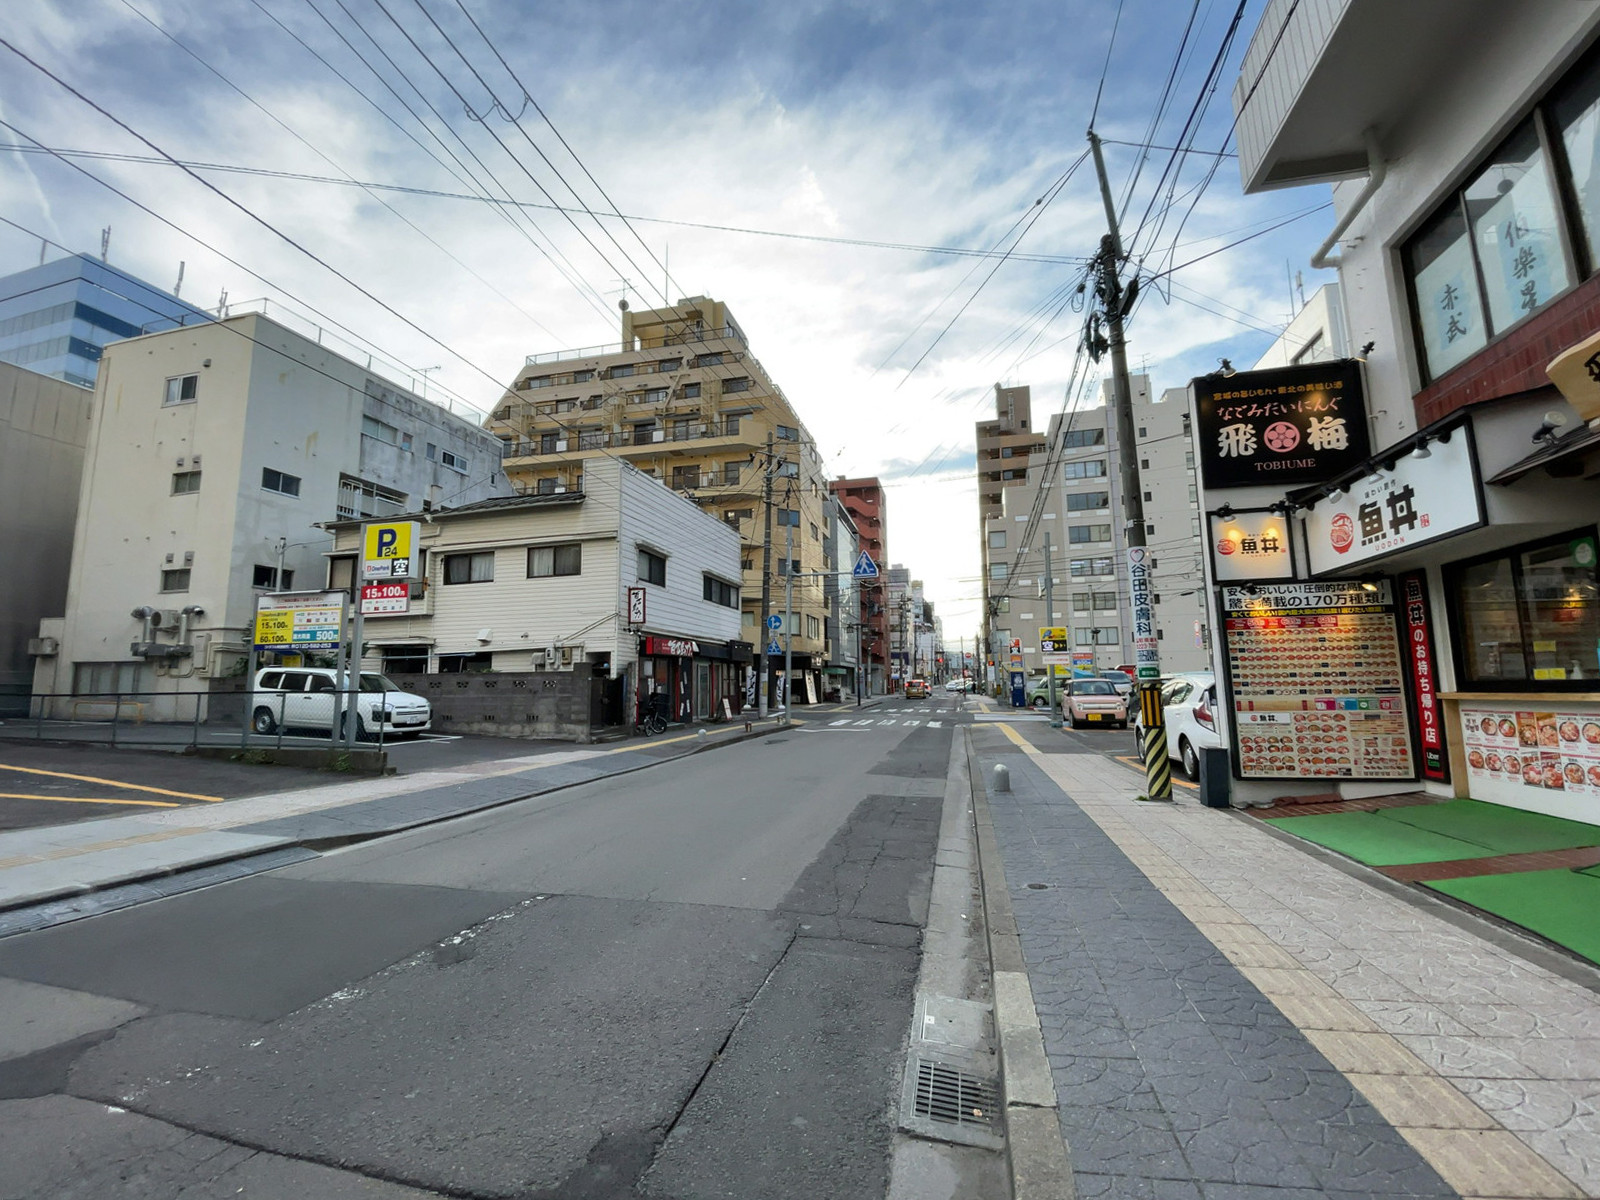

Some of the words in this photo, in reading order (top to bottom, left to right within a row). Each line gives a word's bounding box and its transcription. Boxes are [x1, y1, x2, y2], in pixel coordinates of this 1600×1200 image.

[1217, 415, 1349, 458] 飛梅
[1254, 458, 1316, 471] TOBIUME
[1358, 484, 1418, 547] 魚丼
[377, 528, 397, 557] P
[1375, 536, 1405, 551] UODON
[384, 547, 397, 557] 24
[393, 559, 408, 576] 空
[1131, 564, 1152, 636] 谷田皮膚科
[1426, 752, 1439, 760] Uber
